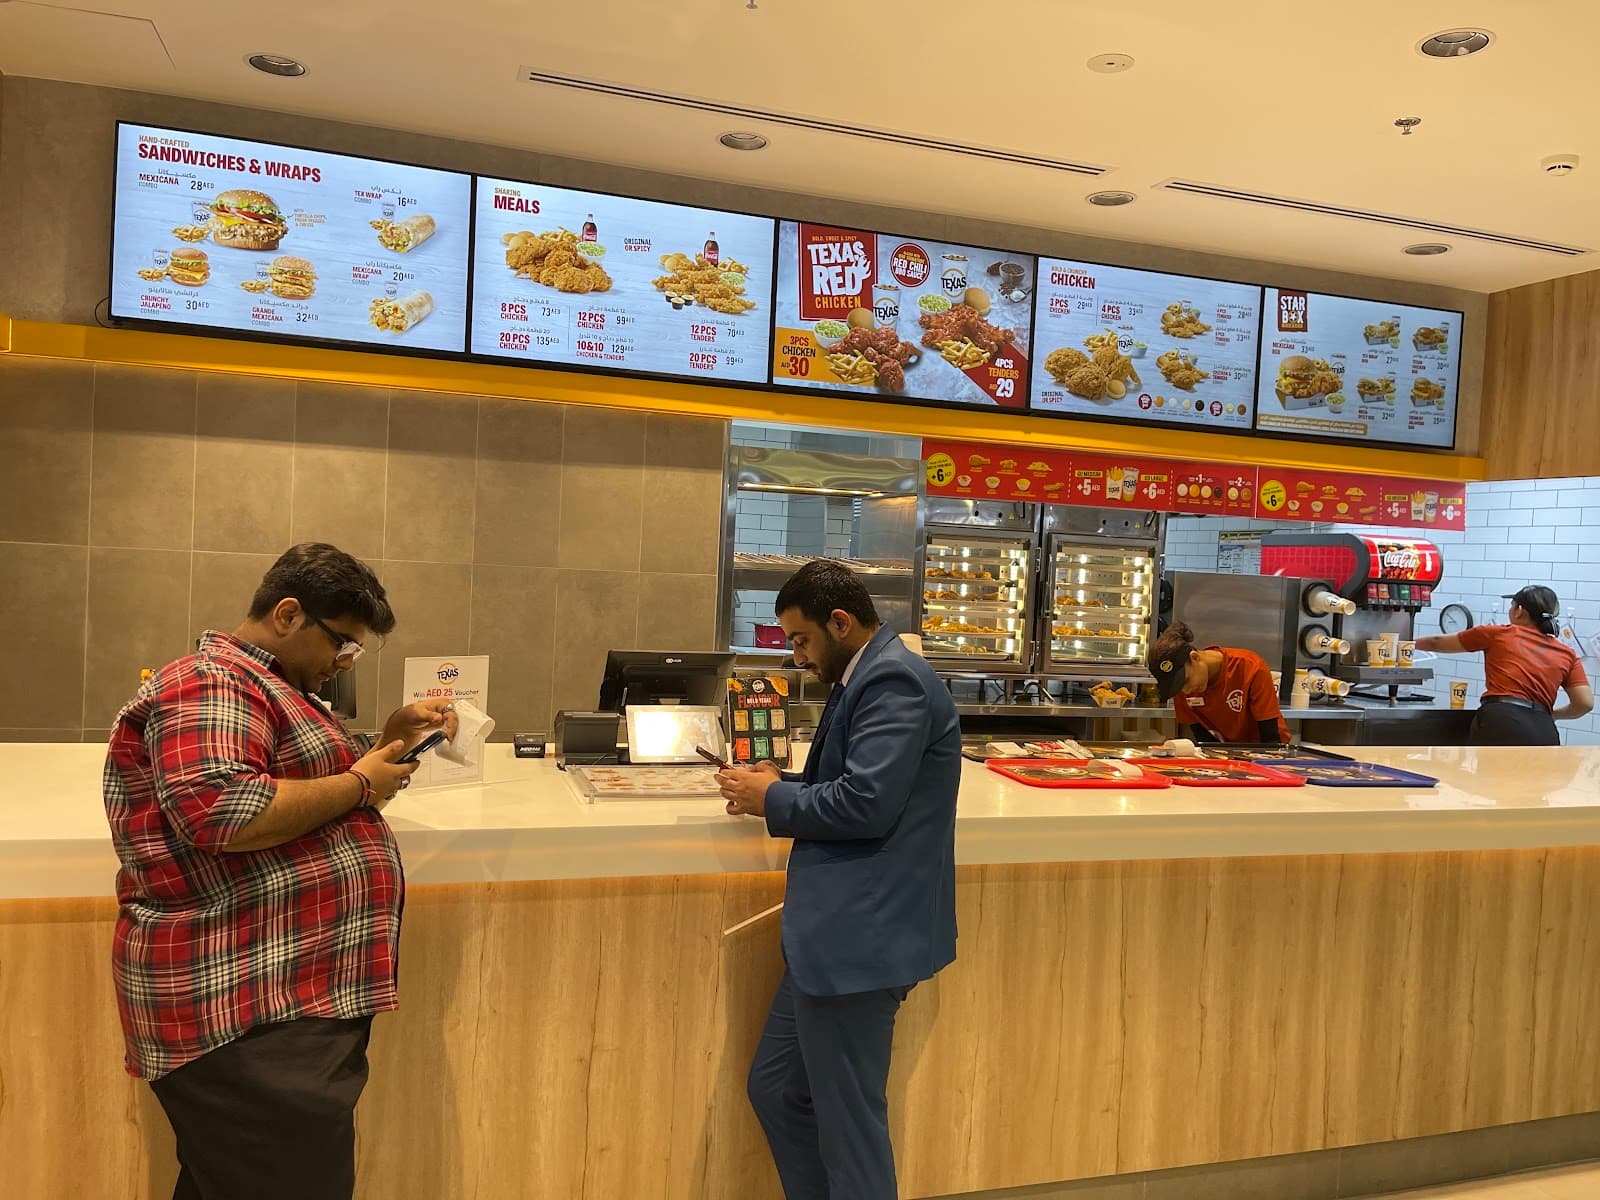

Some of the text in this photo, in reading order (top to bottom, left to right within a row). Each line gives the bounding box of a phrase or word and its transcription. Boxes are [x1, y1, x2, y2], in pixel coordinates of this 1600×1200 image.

[138, 135, 190, 149] HAND-CRAFTED
[138, 144, 321, 183] SANDWICHES & WRAPS
[139, 174, 179, 185] MEXICANA
[190, 180, 203, 190] 28
[365, 191, 383, 199] WRAP
[494, 187, 521, 197] SHARING
[398, 197, 407, 207] 16
[494, 195, 540, 214] MEALS
[624, 238, 652, 246] ORIGINAL
[807, 241, 865, 265] TEXAS
[352, 266, 382, 275] MEXICANA
[894, 258, 928, 274] RED CHILI
[393, 272, 404, 282] 20
[812, 265, 865, 296] RED
[906, 270, 924, 280] SAUCE
[940, 277, 967, 291] TEXAS
[1051, 272, 1096, 290] CHICKEN
[140, 295, 169, 303] CRUNCHY
[816, 296, 862, 309] CHICKEN
[1050, 298, 1069, 308] 3 PCS
[1280, 296, 1306, 311] STAR
[186, 300, 198, 310] 30
[501, 303, 527, 315] 8 PCS
[1102, 305, 1121, 315] 4 PCS
[252, 307, 276, 315] GRANDE
[542, 307, 551, 317] 73
[875, 306, 899, 320] TEXAS
[1050, 307, 1071, 315] CHICKEN
[252, 314, 284, 322] MEXICANA
[296, 312, 308, 323] 32
[501, 313, 529, 322] CHICKEN
[578, 312, 606, 323] 12 PCS
[616, 316, 626, 325] 99
[1102, 313, 1122, 321] CHICKEN
[577, 321, 604, 330] CHICKEN
[691, 324, 717, 336] 12 PCS
[500, 332, 530, 344] 20 PCS
[691, 334, 715, 343] TENDERS
[728, 329, 736, 338] 70
[500, 342, 527, 351] CHICKEN
[536, 336, 550, 346] 135
[577, 340, 604, 352] 10&10
[790, 336, 810, 347] 3PCS
[612, 344, 625, 354] 129
[782, 346, 816, 358] CHICKEN
[690, 353, 717, 364] 20 PCS
[995, 358, 1014, 369] 4PCS
[689, 362, 714, 371] TENDERS
[789, 357, 810, 377] 30
[988, 368, 1020, 380] TENDERS
[996, 378, 1015, 398] 29
[1077, 479, 1092, 496] +5
[1124, 480, 1137, 489] TEXAS
[1142, 483, 1157, 500] +6
[1387, 503, 1400, 518] +5
[1442, 505, 1455, 521] +6
[1384, 549, 1416, 568] Coca-Cola
[437, 668, 459, 681] TEXAS
[426, 689, 442, 698] AED
[444, 688, 453, 697] 25
